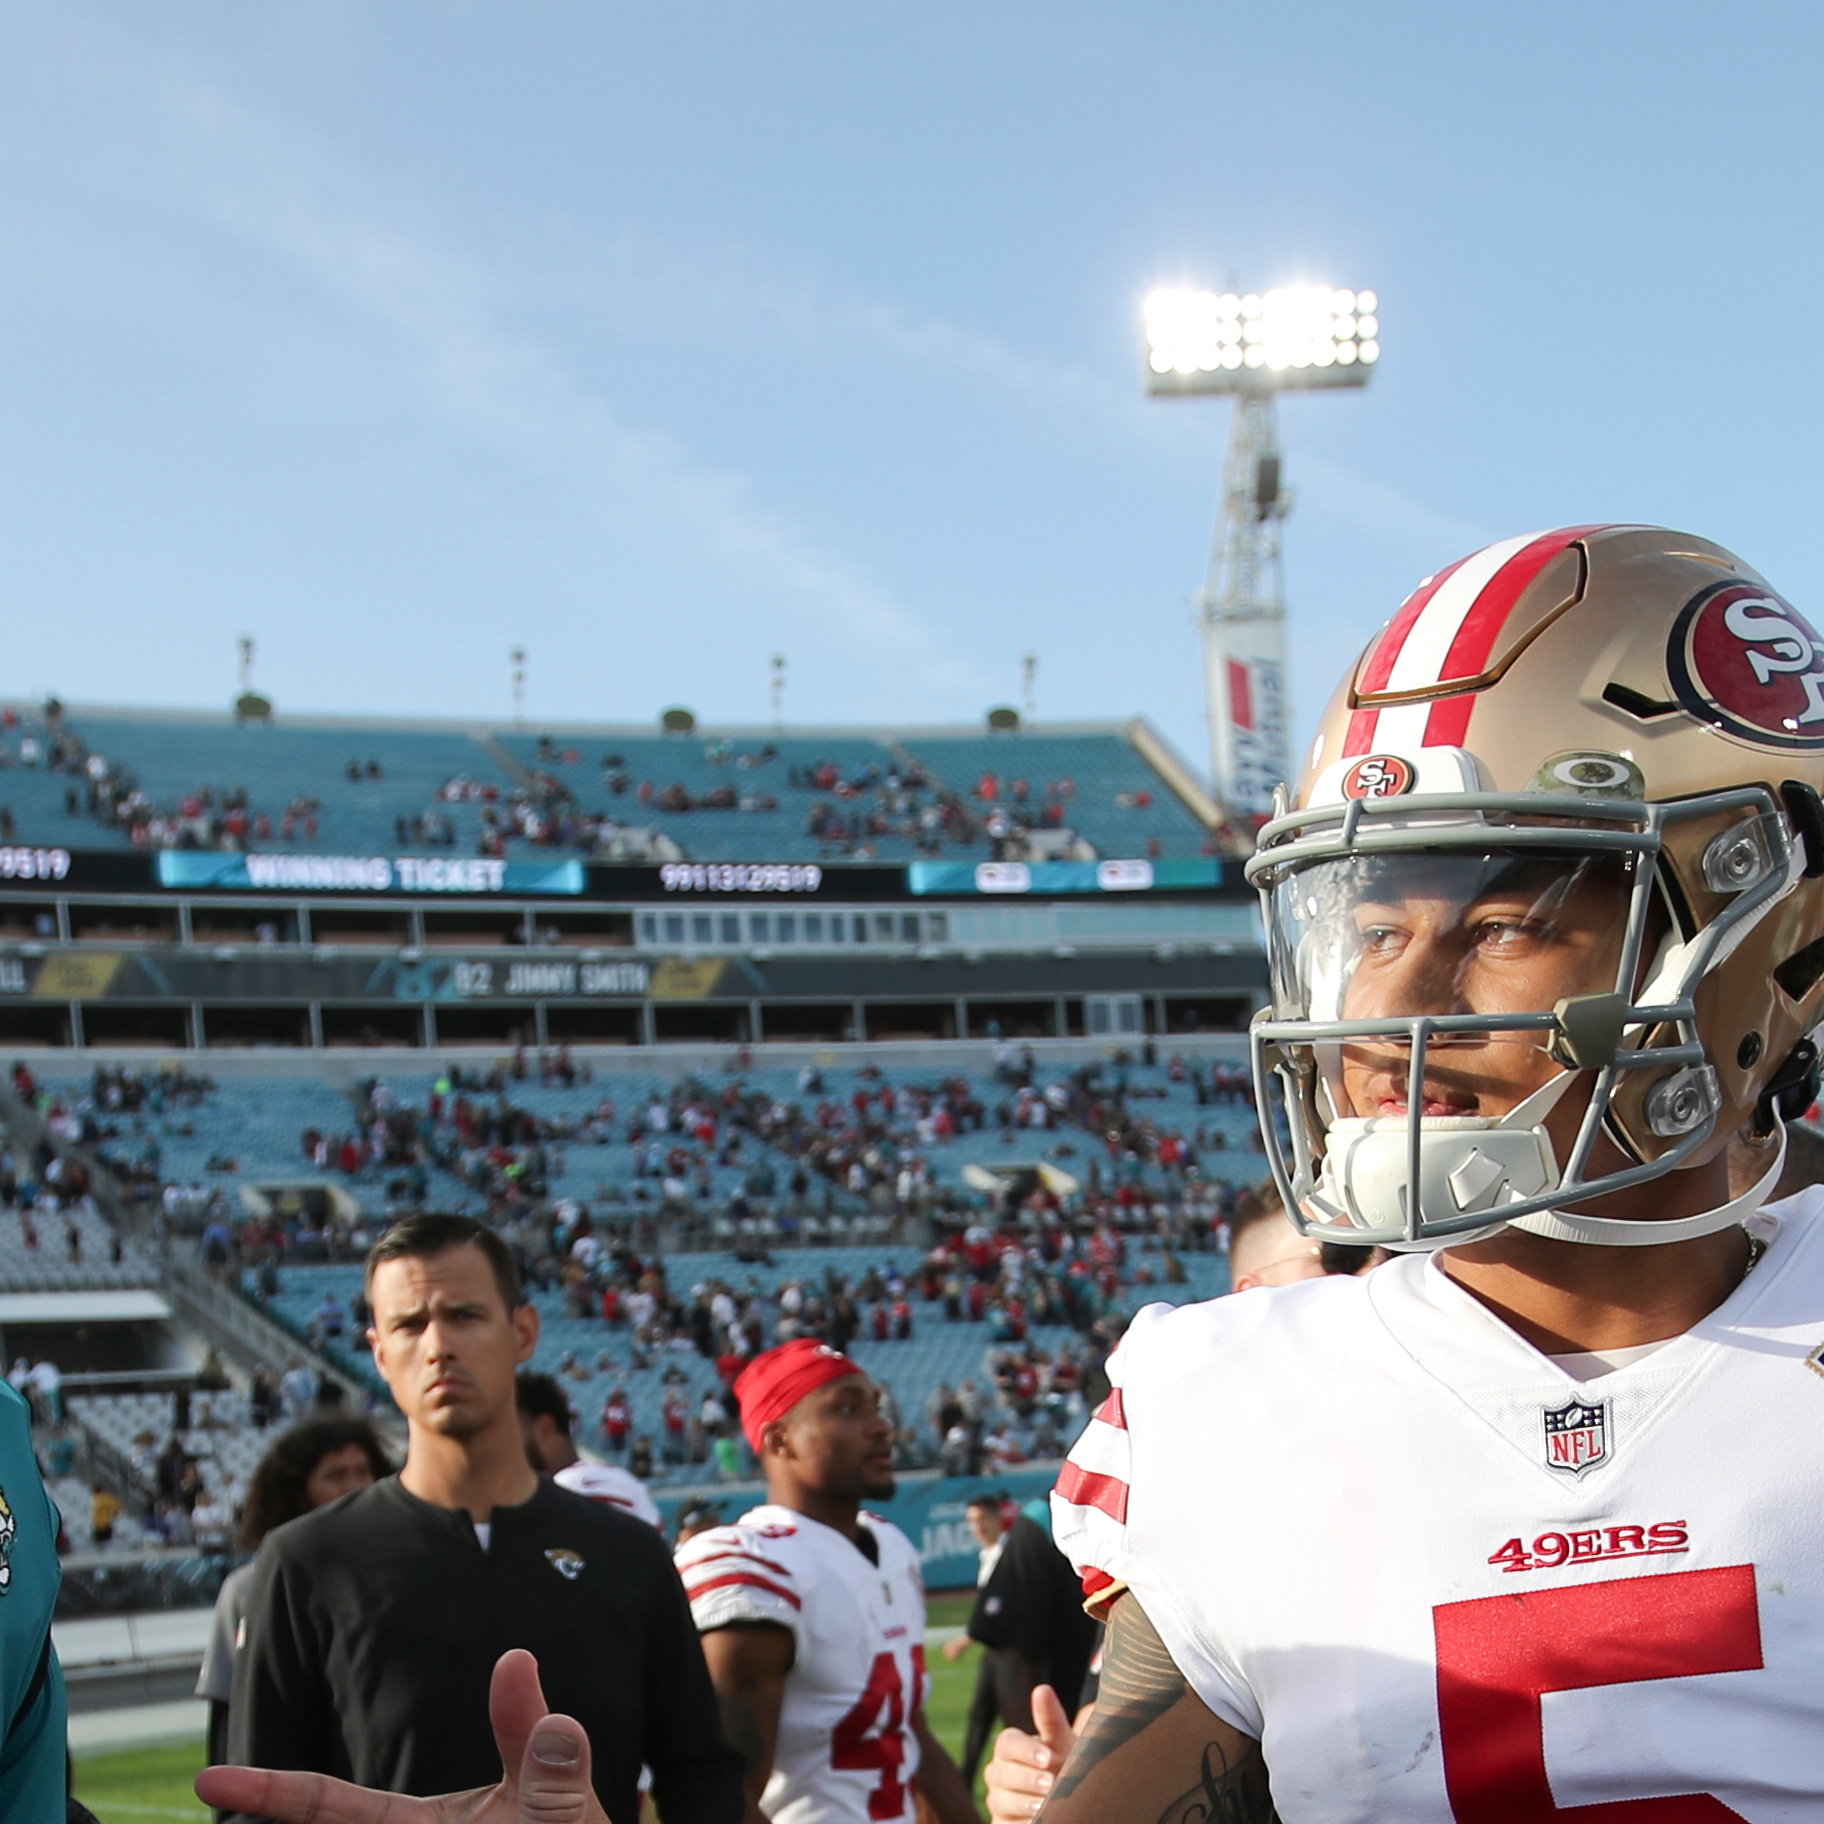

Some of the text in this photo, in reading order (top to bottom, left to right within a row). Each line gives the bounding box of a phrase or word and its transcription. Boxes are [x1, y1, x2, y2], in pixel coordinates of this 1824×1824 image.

[246, 852, 507, 892] WINNING TICKET
[659, 863, 823, 892] 99113129519
[504, 962, 576, 996] JIMMY
[578, 963, 650, 995] SMITH
[1551, 1430, 1602, 1464] NFL
[1487, 1520, 1689, 1573] 49ERS
